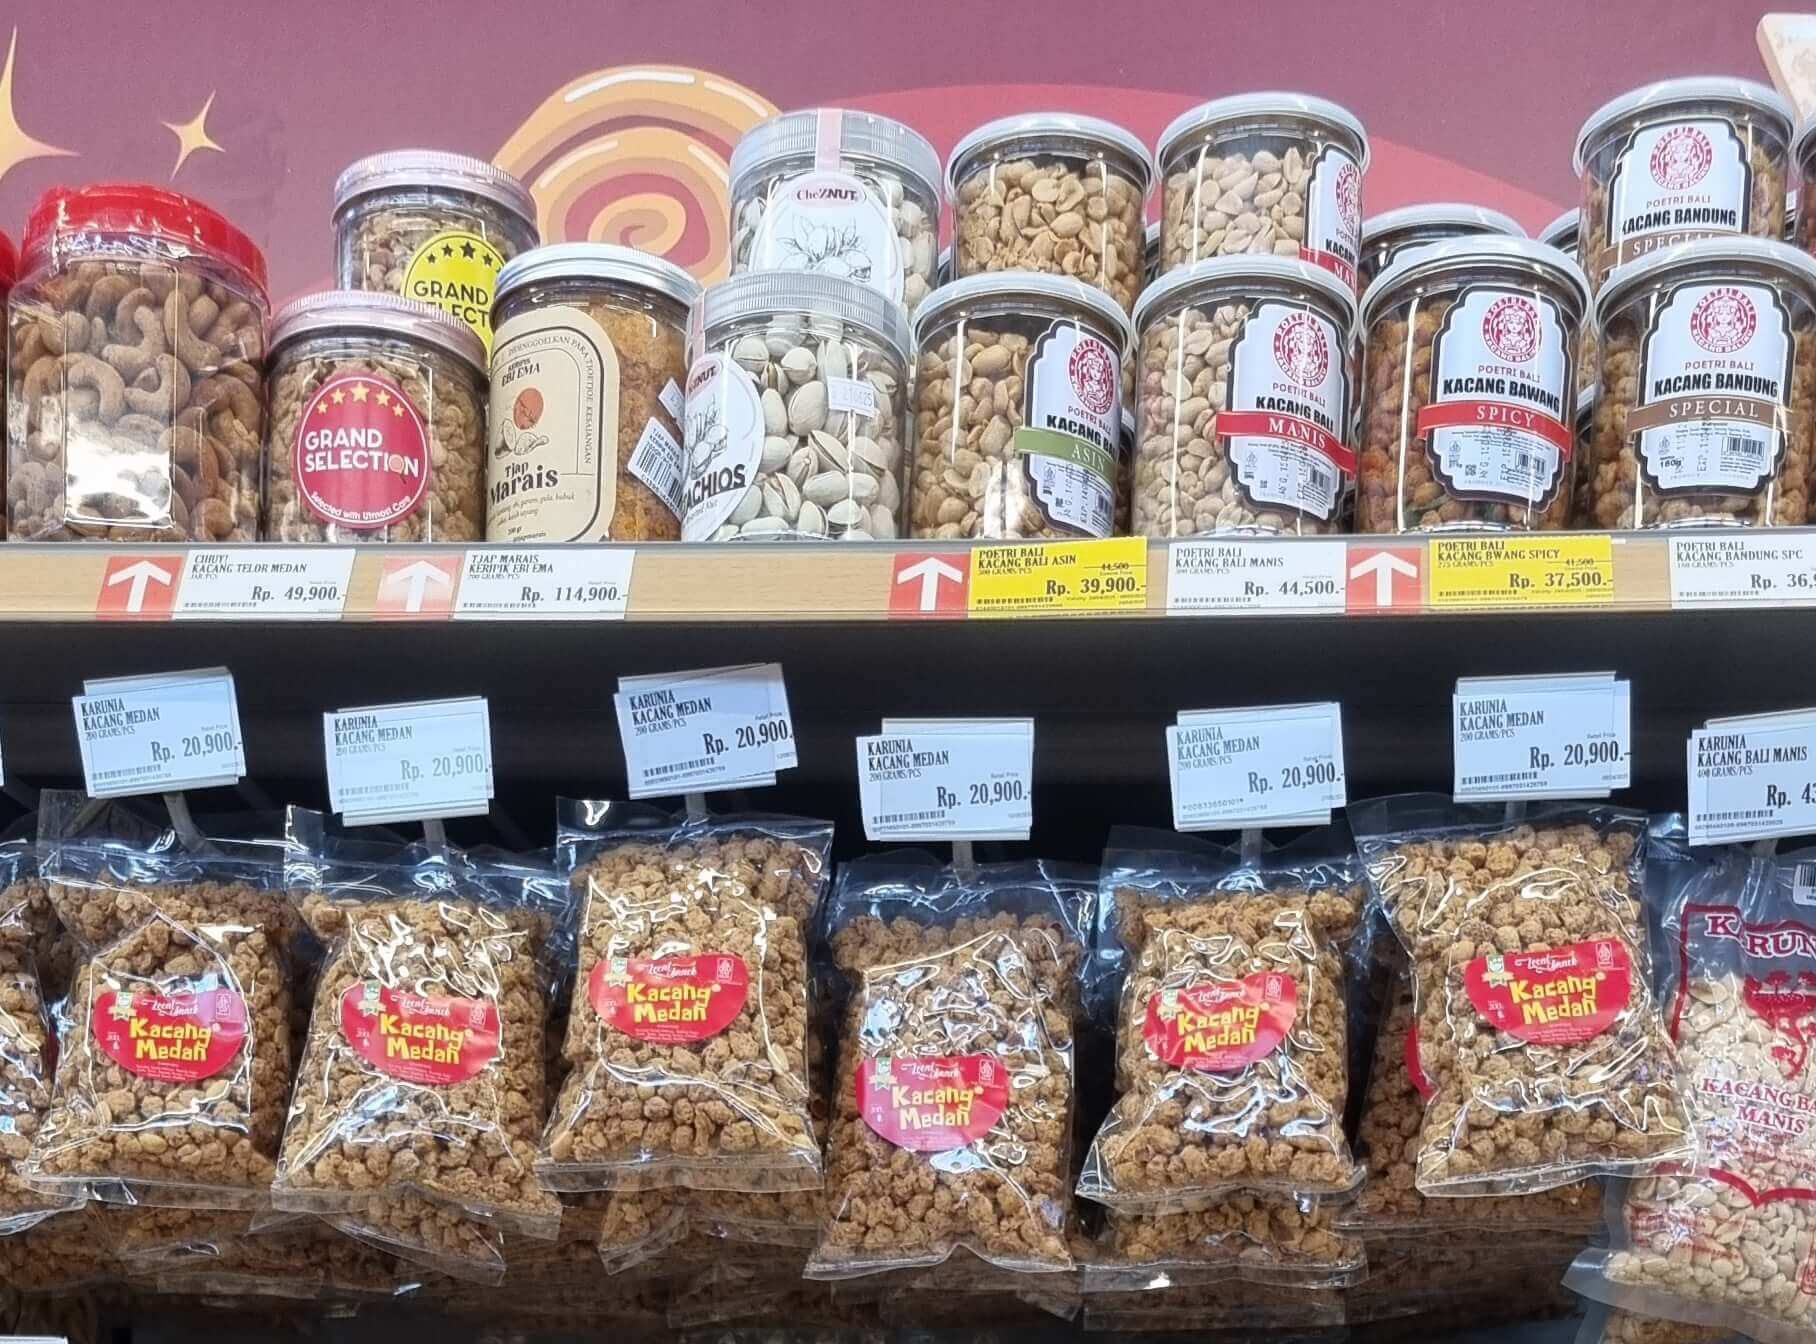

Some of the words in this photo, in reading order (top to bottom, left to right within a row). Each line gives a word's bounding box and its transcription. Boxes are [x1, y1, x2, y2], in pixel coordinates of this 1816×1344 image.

[413, 280, 489, 305] GRAND
[1478, 365, 1518, 379] POETRI
[1520, 372, 1541, 387] BALI
[1685, 361, 1726, 371] POETRI
[1729, 361, 1755, 371] BALI
[1443, 377, 1506, 396] KACANG
[1509, 380, 1560, 414] BAWANG
[1654, 373, 1711, 397] KACANG
[1715, 373, 1778, 398] BANDUNG
[1256, 396, 1311, 417] KACANG
[1313, 407, 1334, 432] BALI
[1476, 405, 1536, 427] SPICY
[1669, 401, 1760, 417] SPECIAL
[305, 428, 382, 450] GRAND
[1046, 415, 1102, 446] KACANG
[1268, 417, 1327, 449] MANIS
[305, 451, 419, 478] SELECTION
[979, 548, 1016, 558] POETRI
[1020, 547, 1044, 557] BALI
[1438, 542, 1476, 552] POETRI
[1480, 541, 1505, 551] BALI
[1438, 551, 1481, 561] KACANG
[1484, 550, 1525, 560] BWANG
[1529, 549, 1560, 560] SPICY
[192, 564, 233, 573] KACANG
[236, 564, 267, 573] TELOR
[270, 563, 307, 573] MEDAN
[469, 564, 511, 573] KERIPIK
[514, 564, 529, 573] EBI
[532, 564, 553, 573] EMA
[473, 555, 497, 564] TJAP
[500, 555, 539, 564] MARAIS
[978, 558, 1021, 568] KACANG
[1024, 557, 1047, 567] BALI
[1051, 555, 1076, 565] ASIN
[1046, 580, 1071, 596] Rp.
[1510, 574, 1535, 590] Rp.
[252, 587, 274, 602] Rp.
[521, 587, 544, 602] Rp.
[630, 690, 675, 711] KARUNIA
[632, 704, 674, 725] KACANG
[677, 697, 712, 717] MEDAN
[1460, 699, 1507, 716] KARUNIA
[635, 723, 648, 736] 200
[1460, 715, 1504, 731] KACANG
[1506, 711, 1544, 727] MEDAN
[703, 733, 729, 755] Rp.
[1698, 735, 1746, 752] KARUNIA
[1530, 746, 1554, 770] Rp.
[1564, 740, 1632, 767] 20,900.-
[1697, 751, 1741, 767] KACANG
[1745, 748, 1770, 764] BALI
[1773, 746, 1808, 762] MANIS
[626, 983, 711, 1009] Kacang
[1510, 975, 1597, 1004] Kacang
[634, 1001, 707, 1023] Medan
[1522, 995, 1597, 1025] Medan
